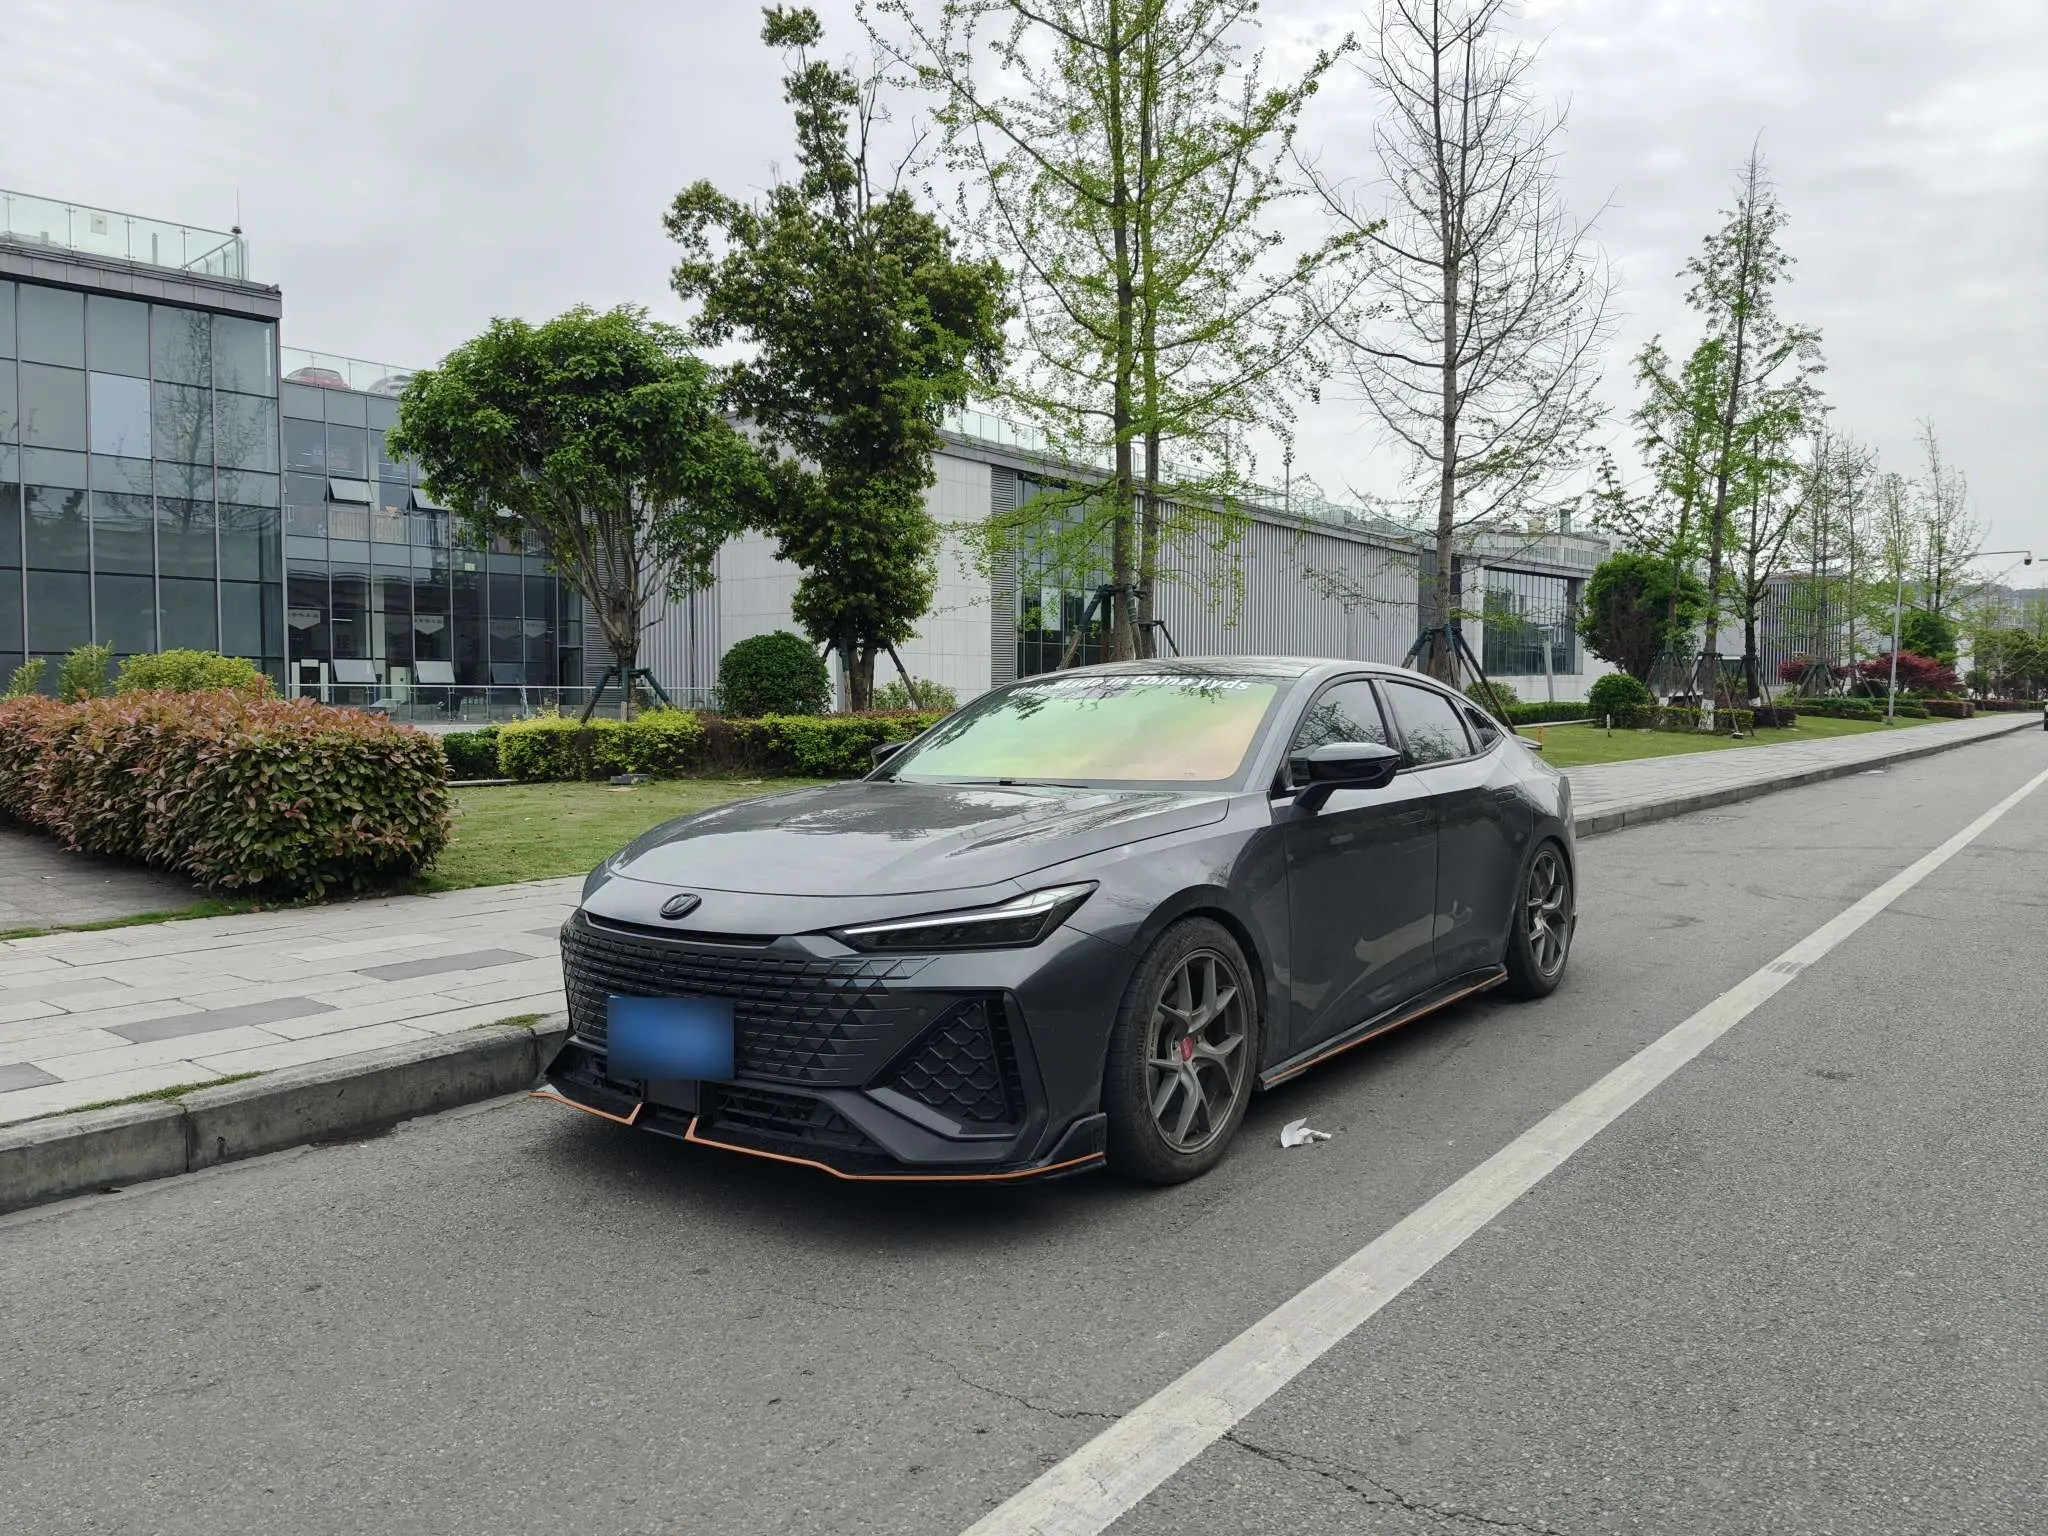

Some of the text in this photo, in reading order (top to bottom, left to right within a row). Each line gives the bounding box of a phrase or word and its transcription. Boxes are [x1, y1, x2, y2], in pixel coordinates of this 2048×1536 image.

[1106, 676, 1128, 686] in
[1131, 675, 1193, 686] China
[1193, 679, 1252, 690] yyds
